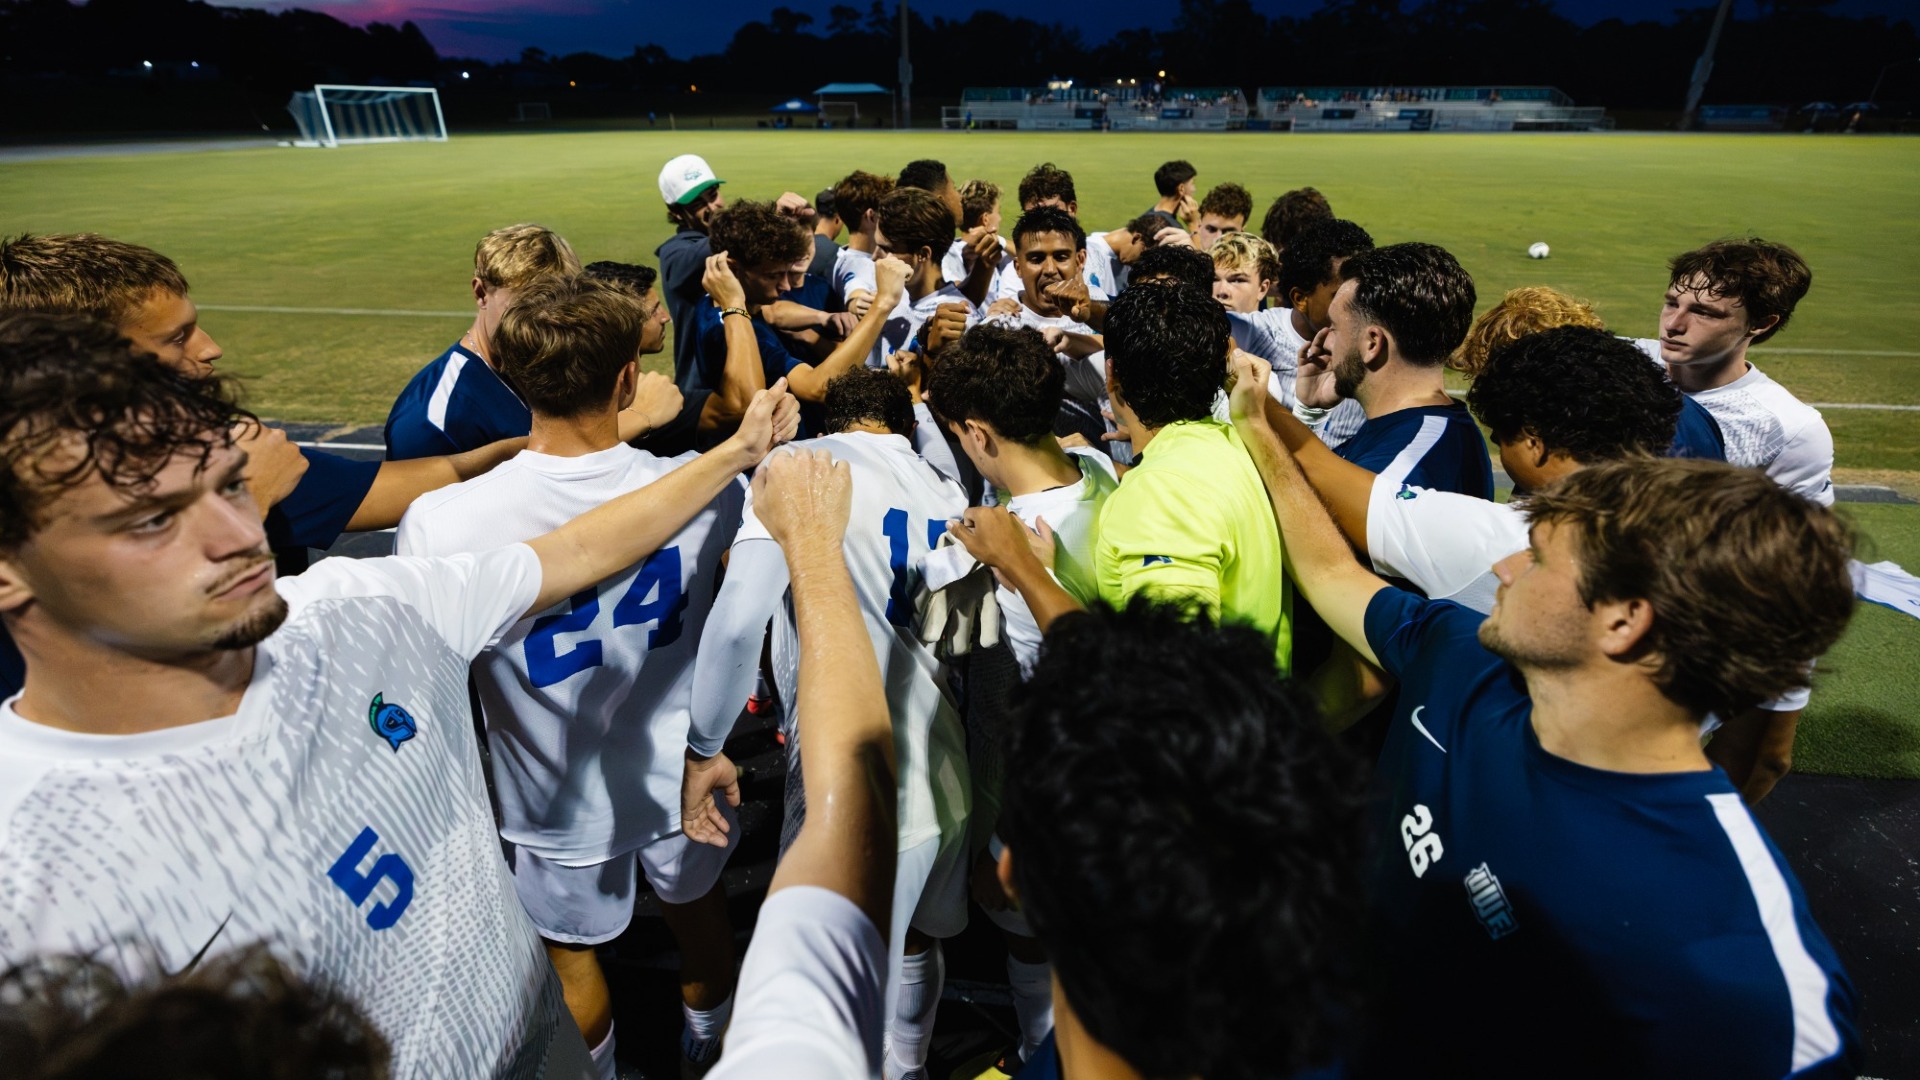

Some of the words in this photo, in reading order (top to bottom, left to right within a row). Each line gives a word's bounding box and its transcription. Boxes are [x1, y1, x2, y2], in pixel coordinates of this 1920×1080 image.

[524, 545, 689, 688] 24
[883, 508, 963, 627] 1
[327, 826, 414, 931] 5
[1401, 804, 1443, 878] 26
